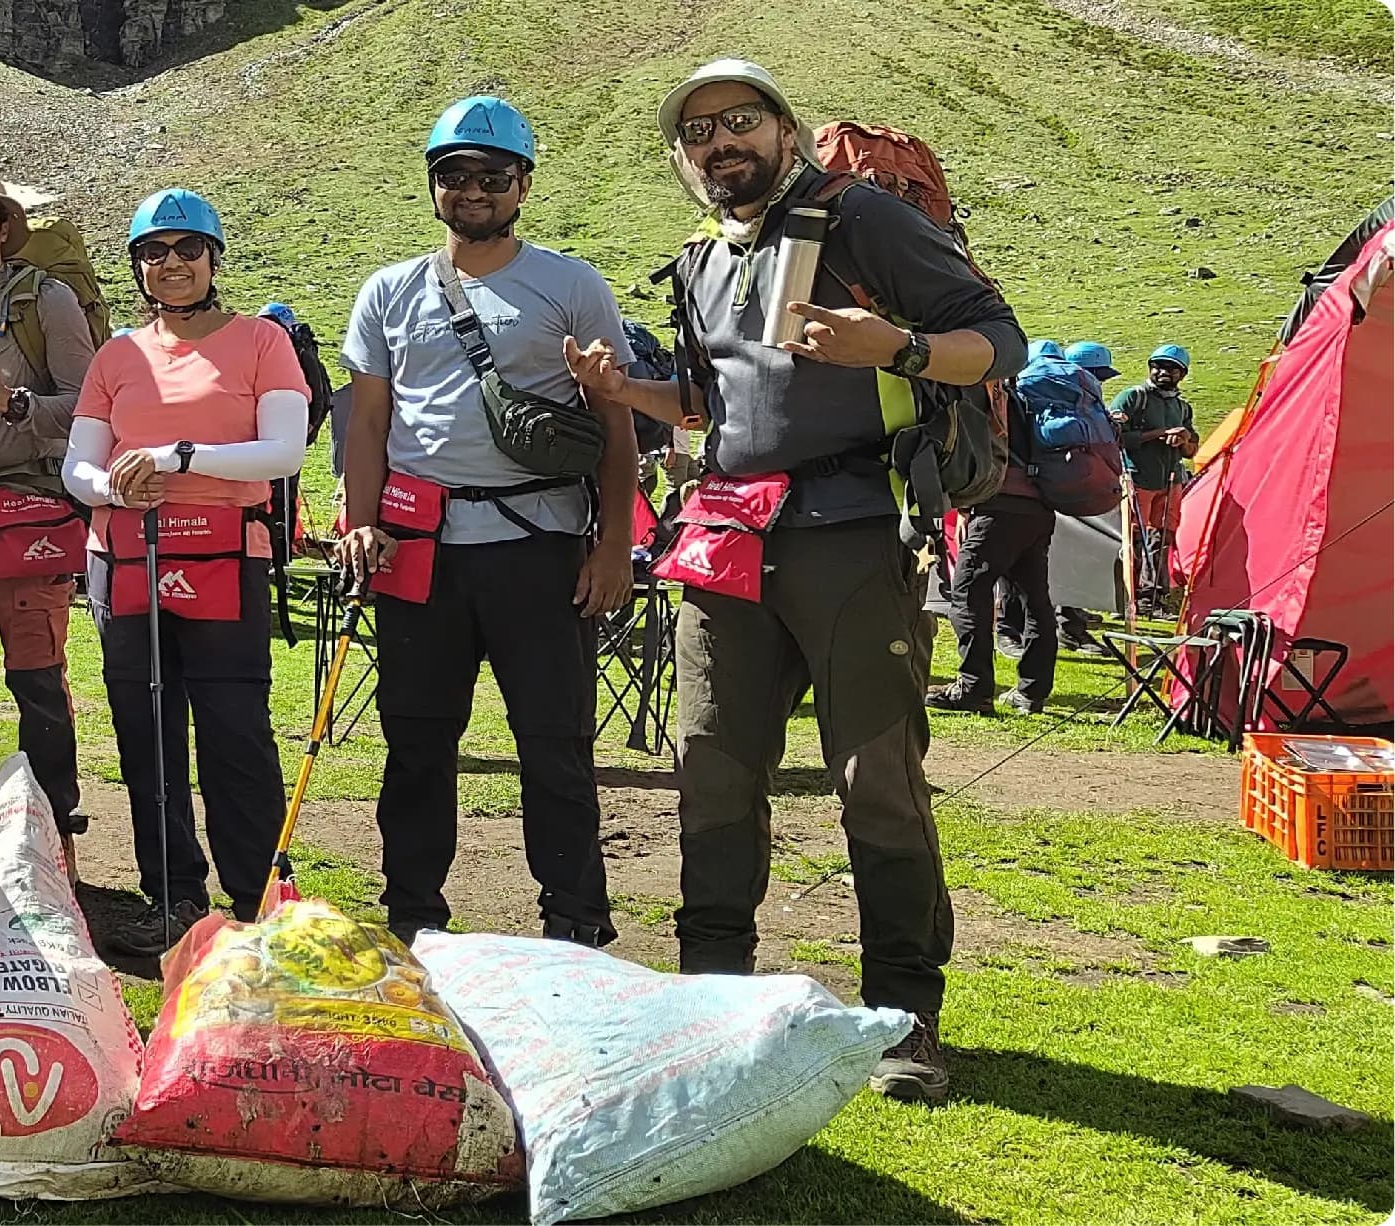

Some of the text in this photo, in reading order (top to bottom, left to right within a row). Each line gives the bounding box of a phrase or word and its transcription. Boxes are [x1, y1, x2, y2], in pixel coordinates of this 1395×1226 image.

[168, 516, 208, 528] Himala
[1316, 804, 1327, 856] LFC
[2, 973, 72, 994] ELBOW
[4, 1003, 50, 1016] QUALITY
